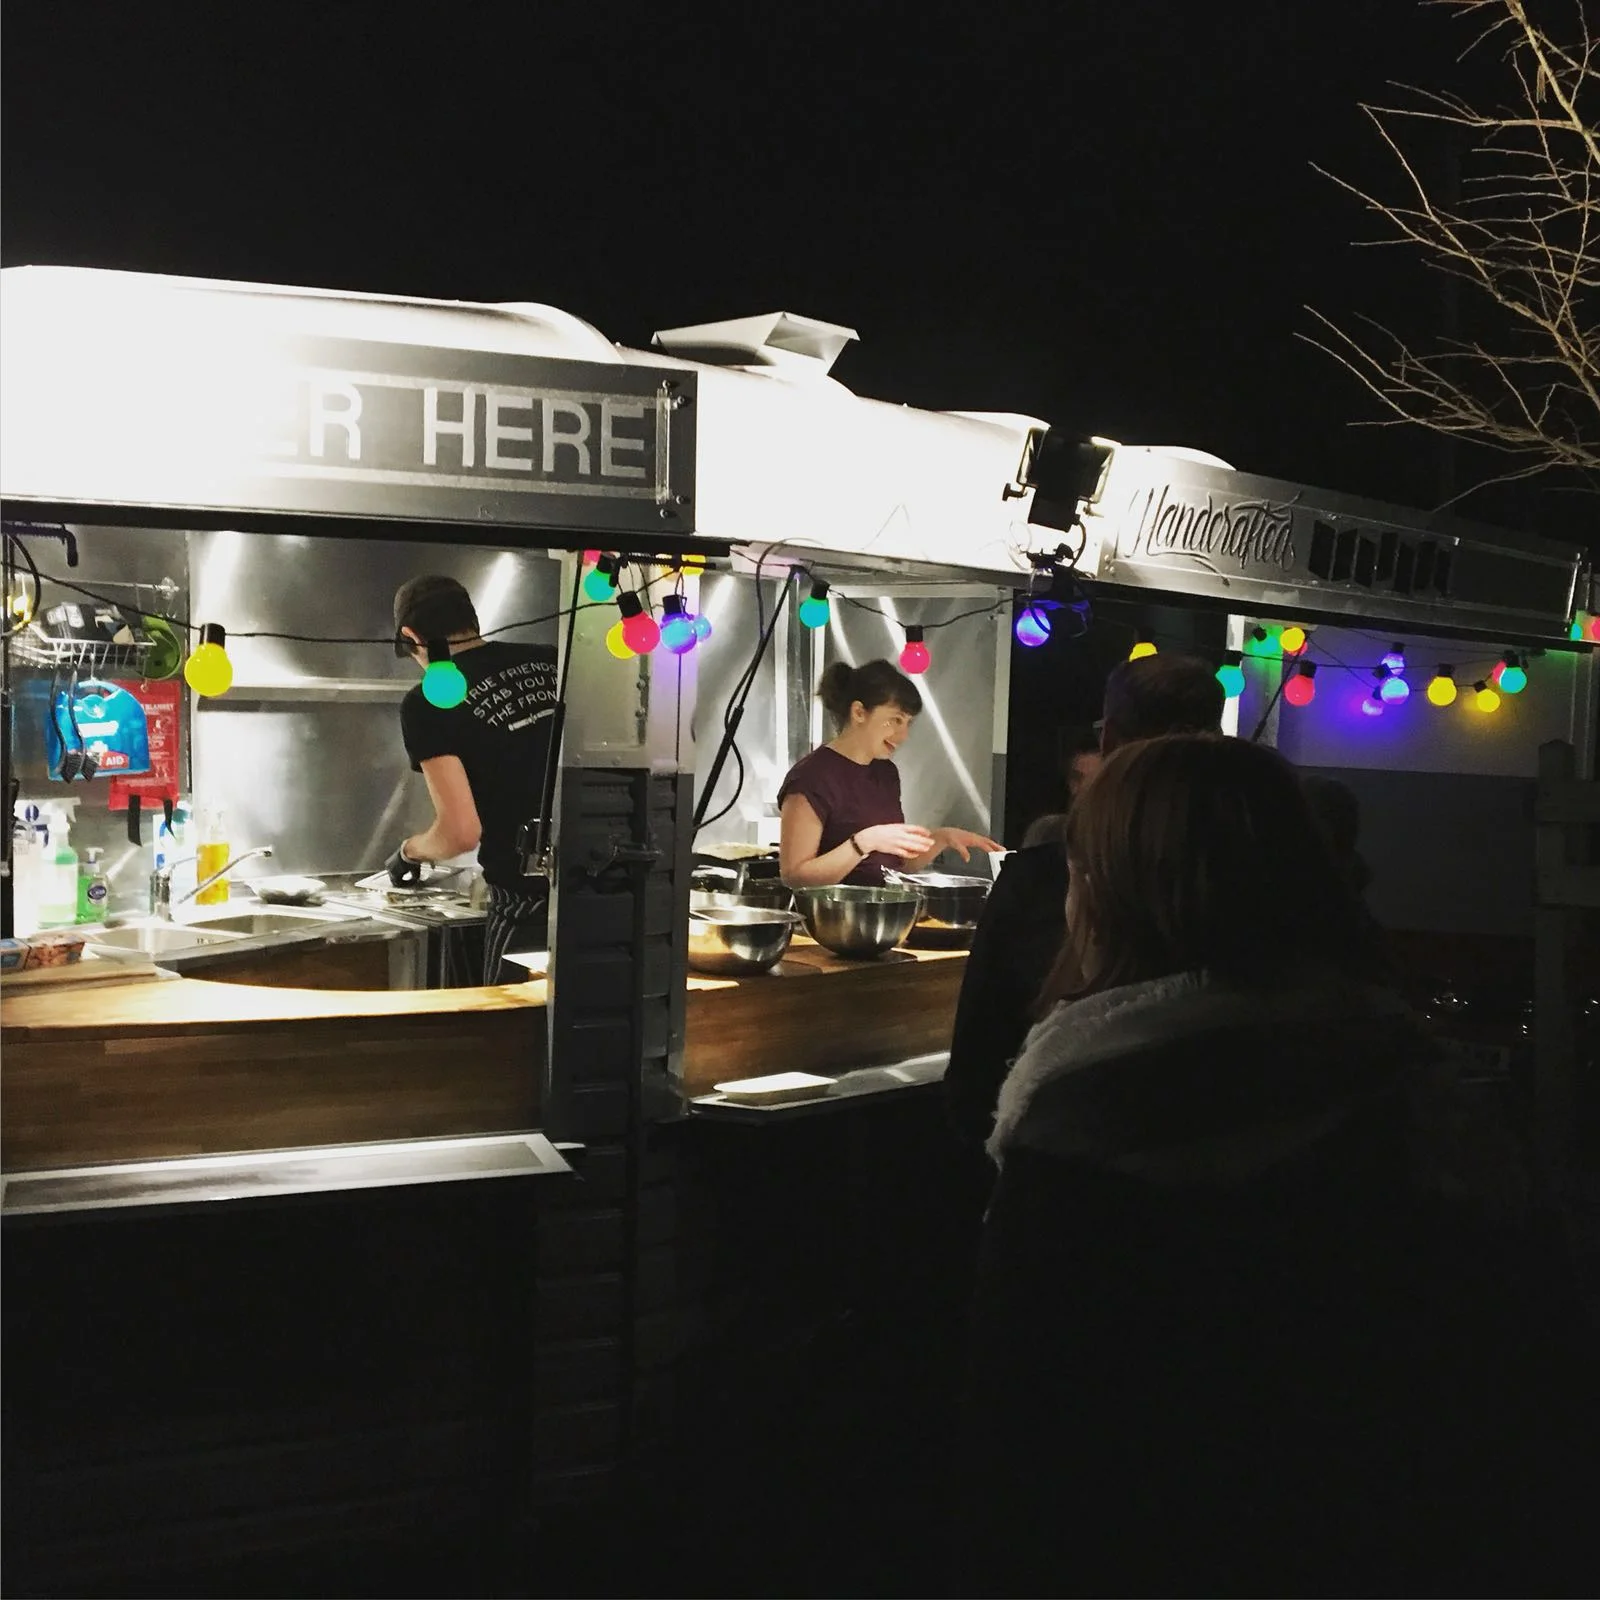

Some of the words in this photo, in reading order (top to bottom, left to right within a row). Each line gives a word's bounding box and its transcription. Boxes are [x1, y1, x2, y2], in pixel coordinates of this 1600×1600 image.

[423, 386, 647, 480] HERE
[1123, 484, 1302, 588] Handcrafted
[499, 662, 558, 681] FRIENDS
[473, 688, 512, 719] STAB
[515, 676, 545, 691] YOU
[487, 702, 516, 727] THE
[517, 690, 556, 709] FRON
[106, 755, 124, 766] AID
